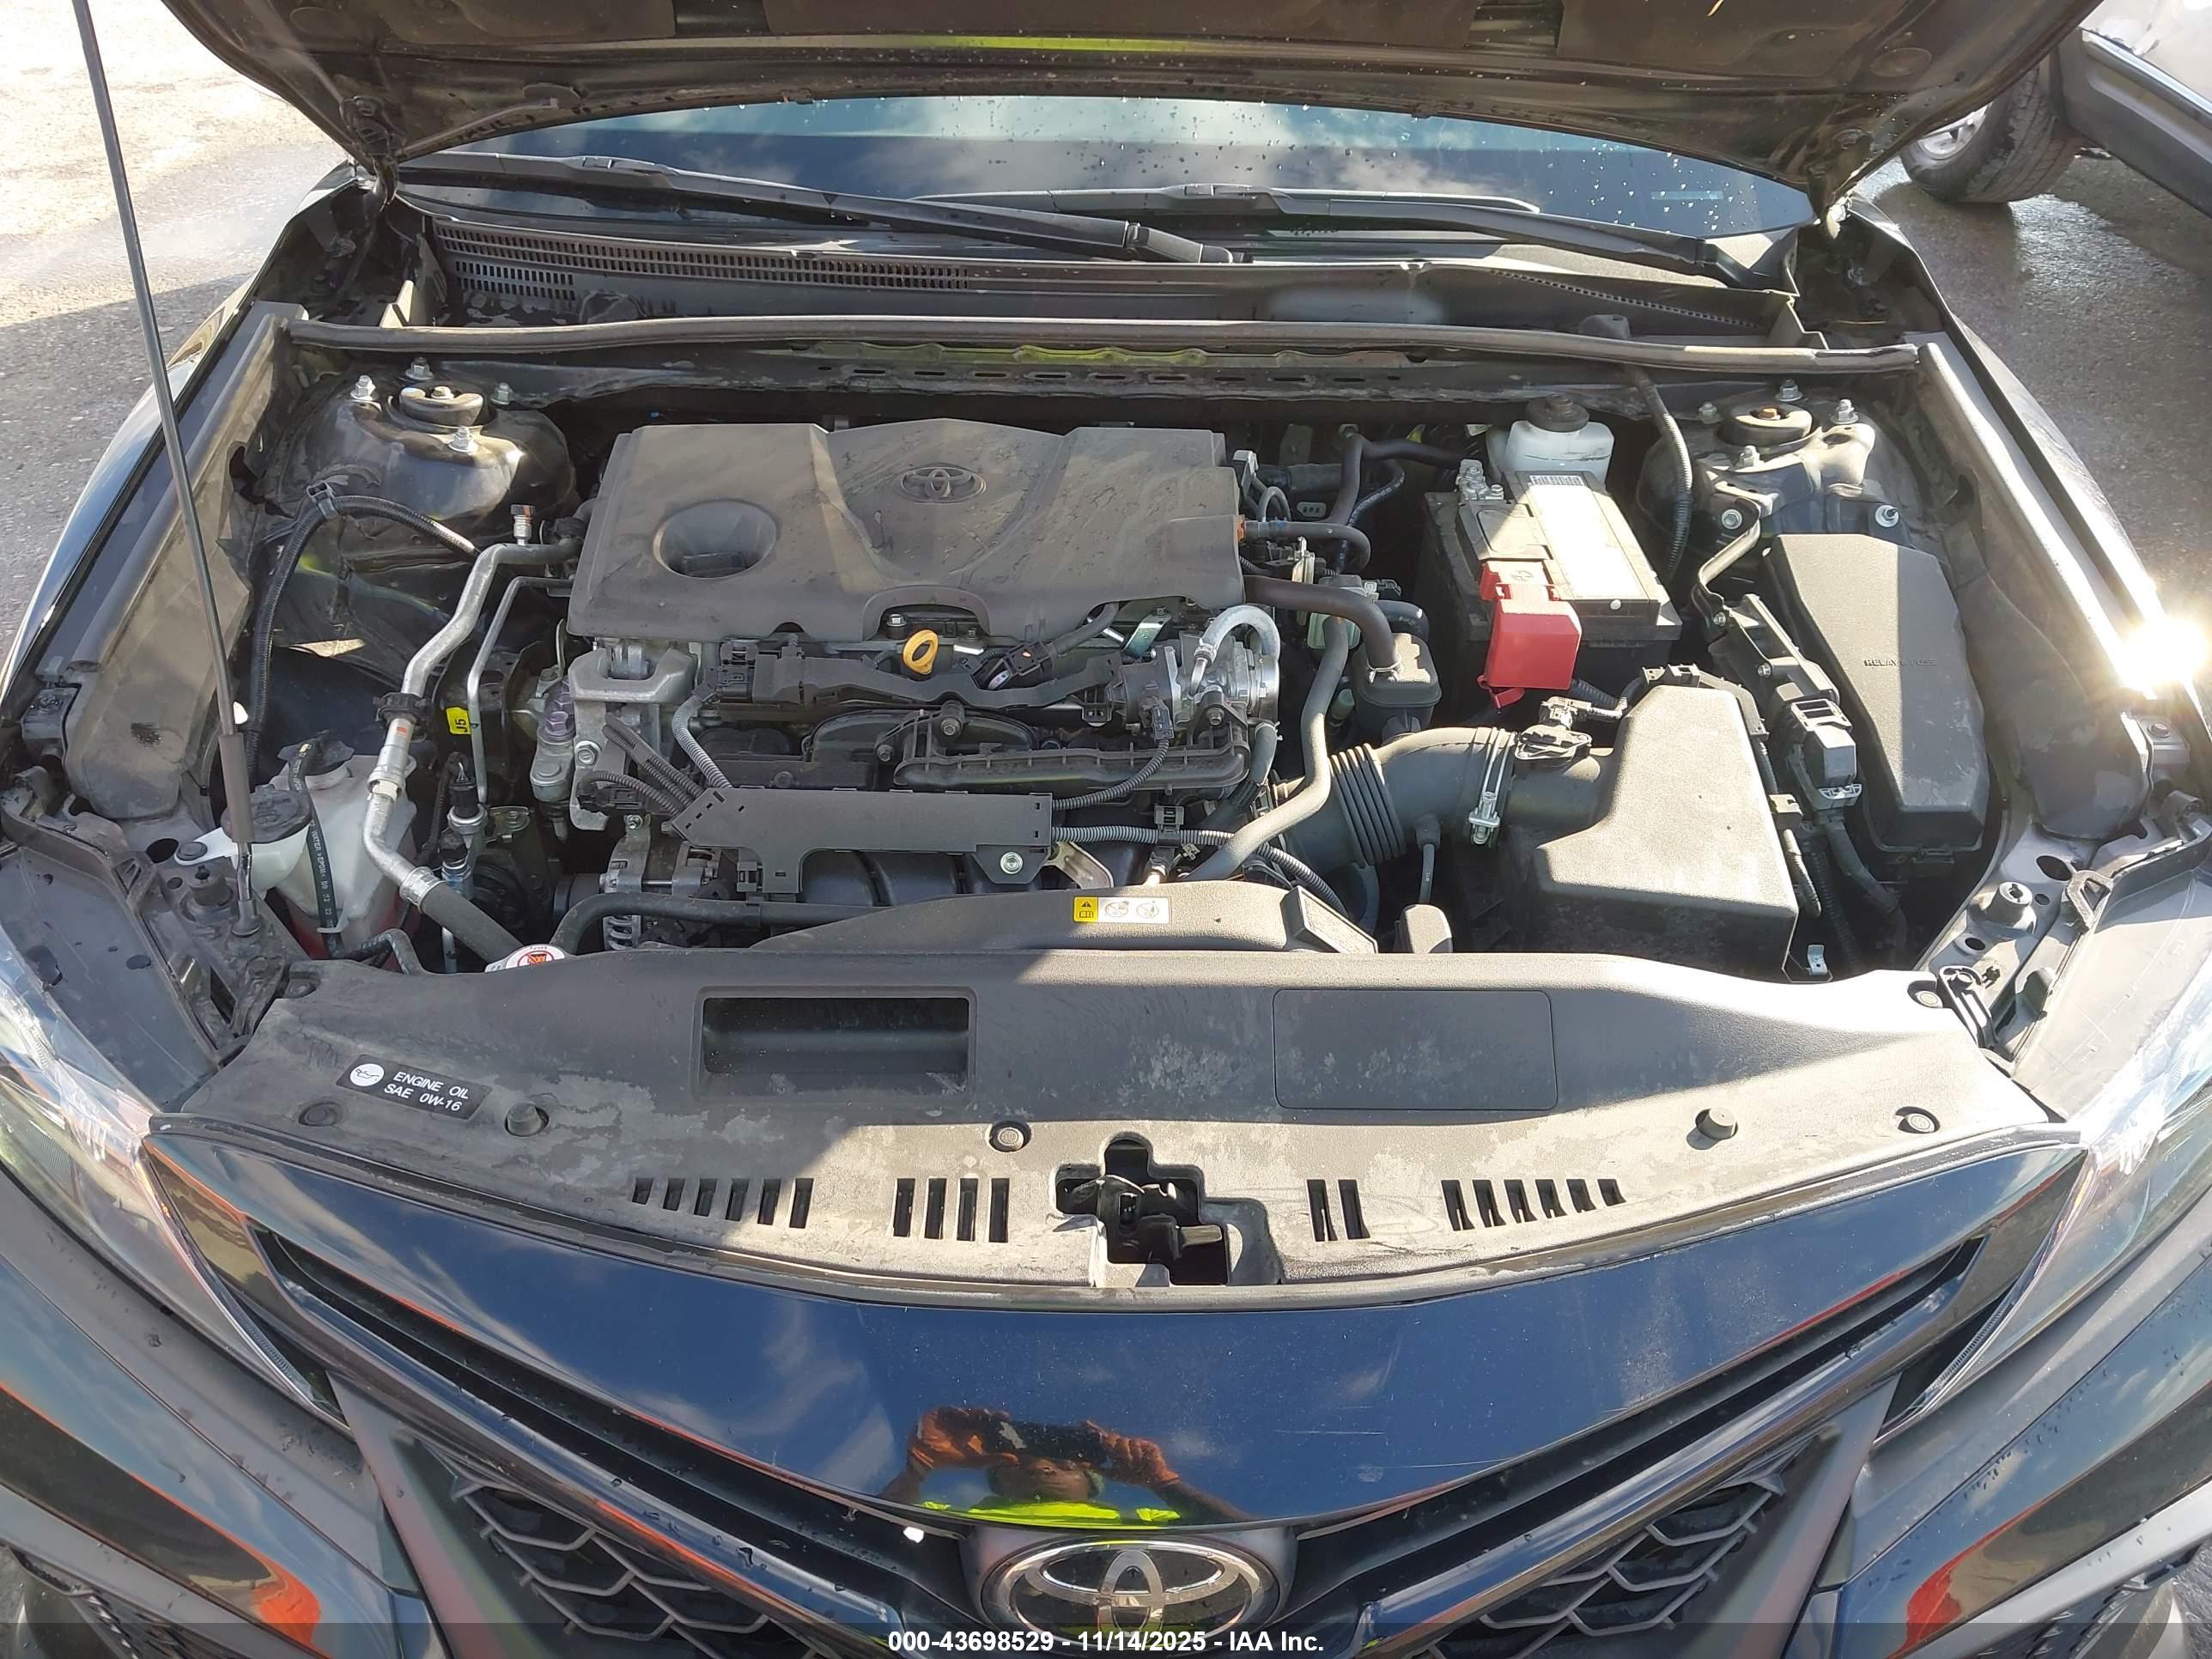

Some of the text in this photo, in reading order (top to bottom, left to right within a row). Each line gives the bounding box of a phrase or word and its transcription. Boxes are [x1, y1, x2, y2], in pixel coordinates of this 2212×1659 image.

[454, 719, 468, 732] J5
[311, 830, 322, 851] WATER
[392, 1071, 470, 1099] ENGINE OIL
[384, 1084, 462, 1111] SAE 0W-16
